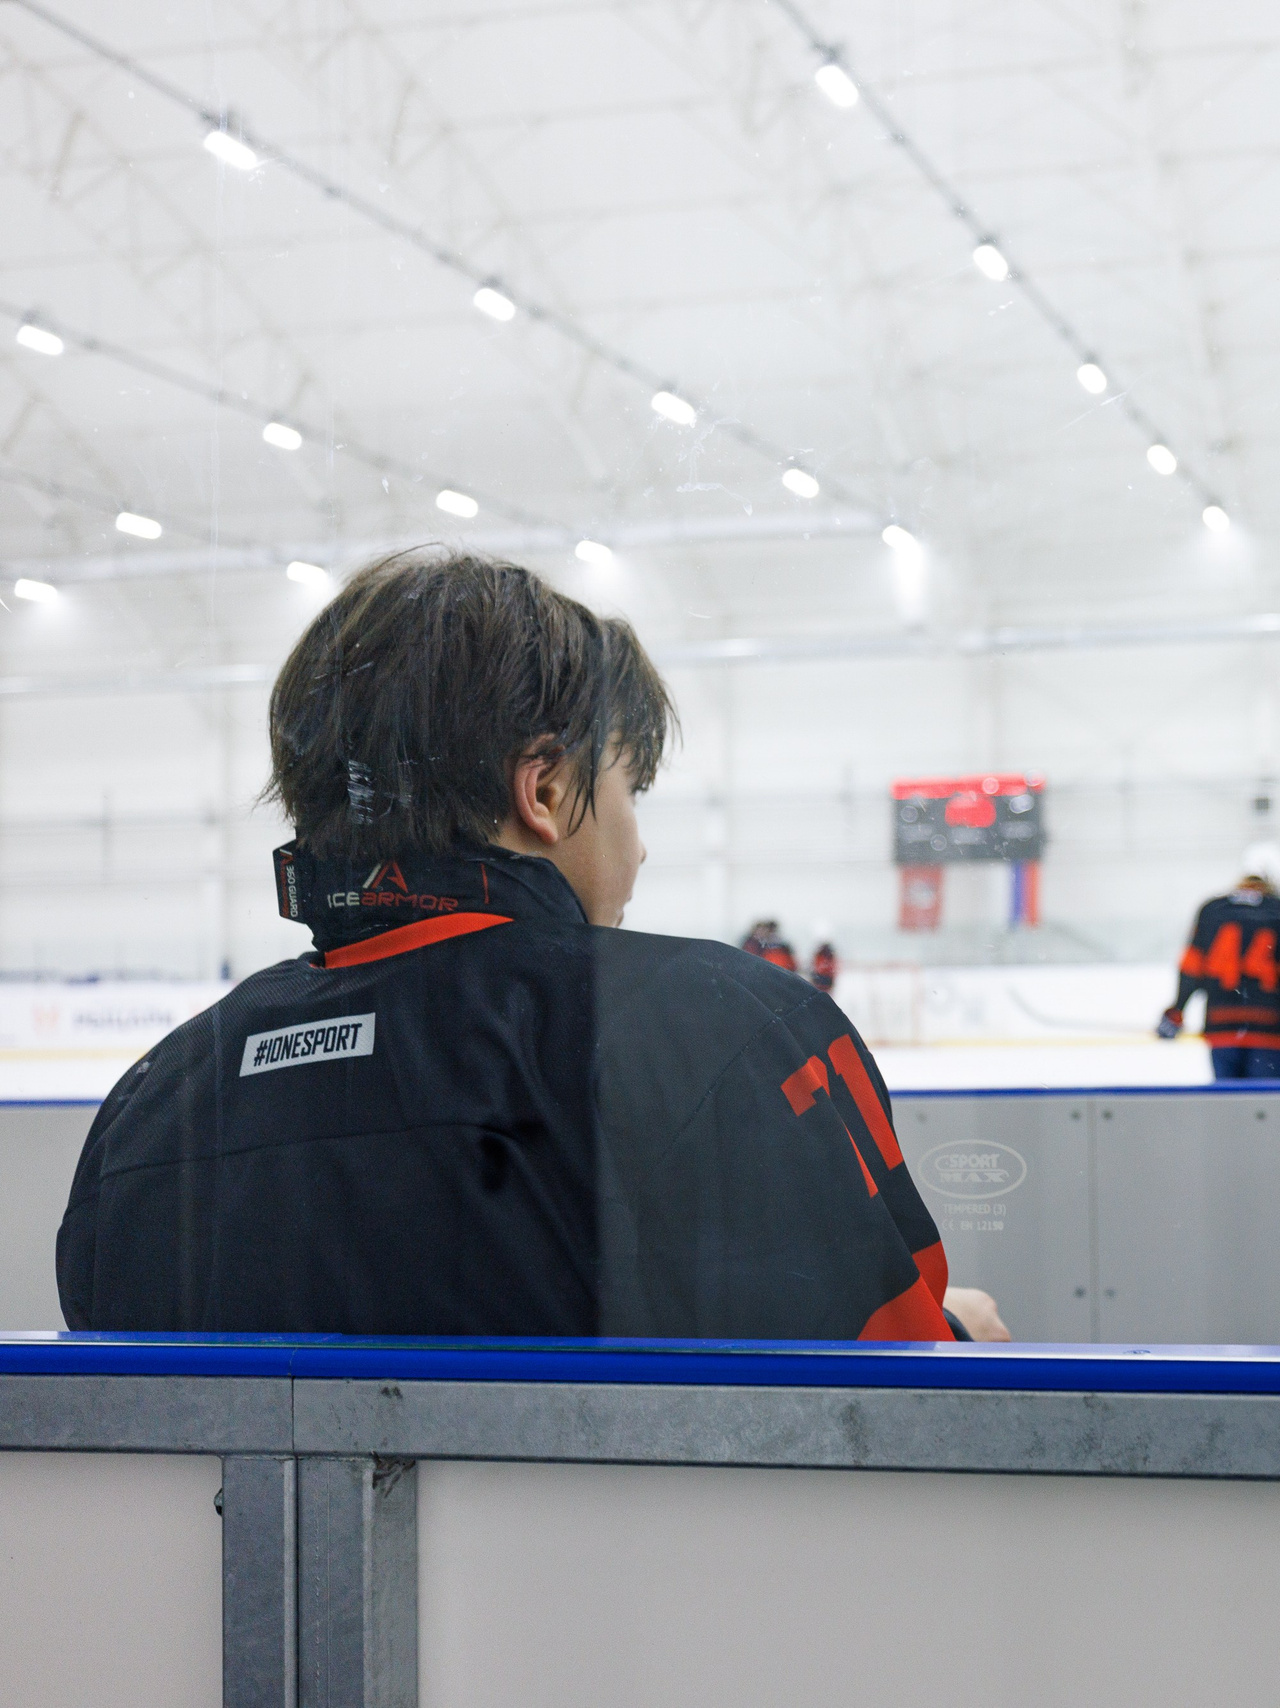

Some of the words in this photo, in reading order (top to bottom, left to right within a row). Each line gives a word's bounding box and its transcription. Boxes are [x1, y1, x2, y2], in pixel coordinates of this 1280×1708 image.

[285, 864, 296, 884] 360
[288, 885, 298, 918] GUARD
[1205, 921, 1279, 993] 44
[948, 1153, 1000, 1168] SPORT
[939, 1172, 1006, 1183] MAX
[942, 1203, 991, 1214] TEMPERED
